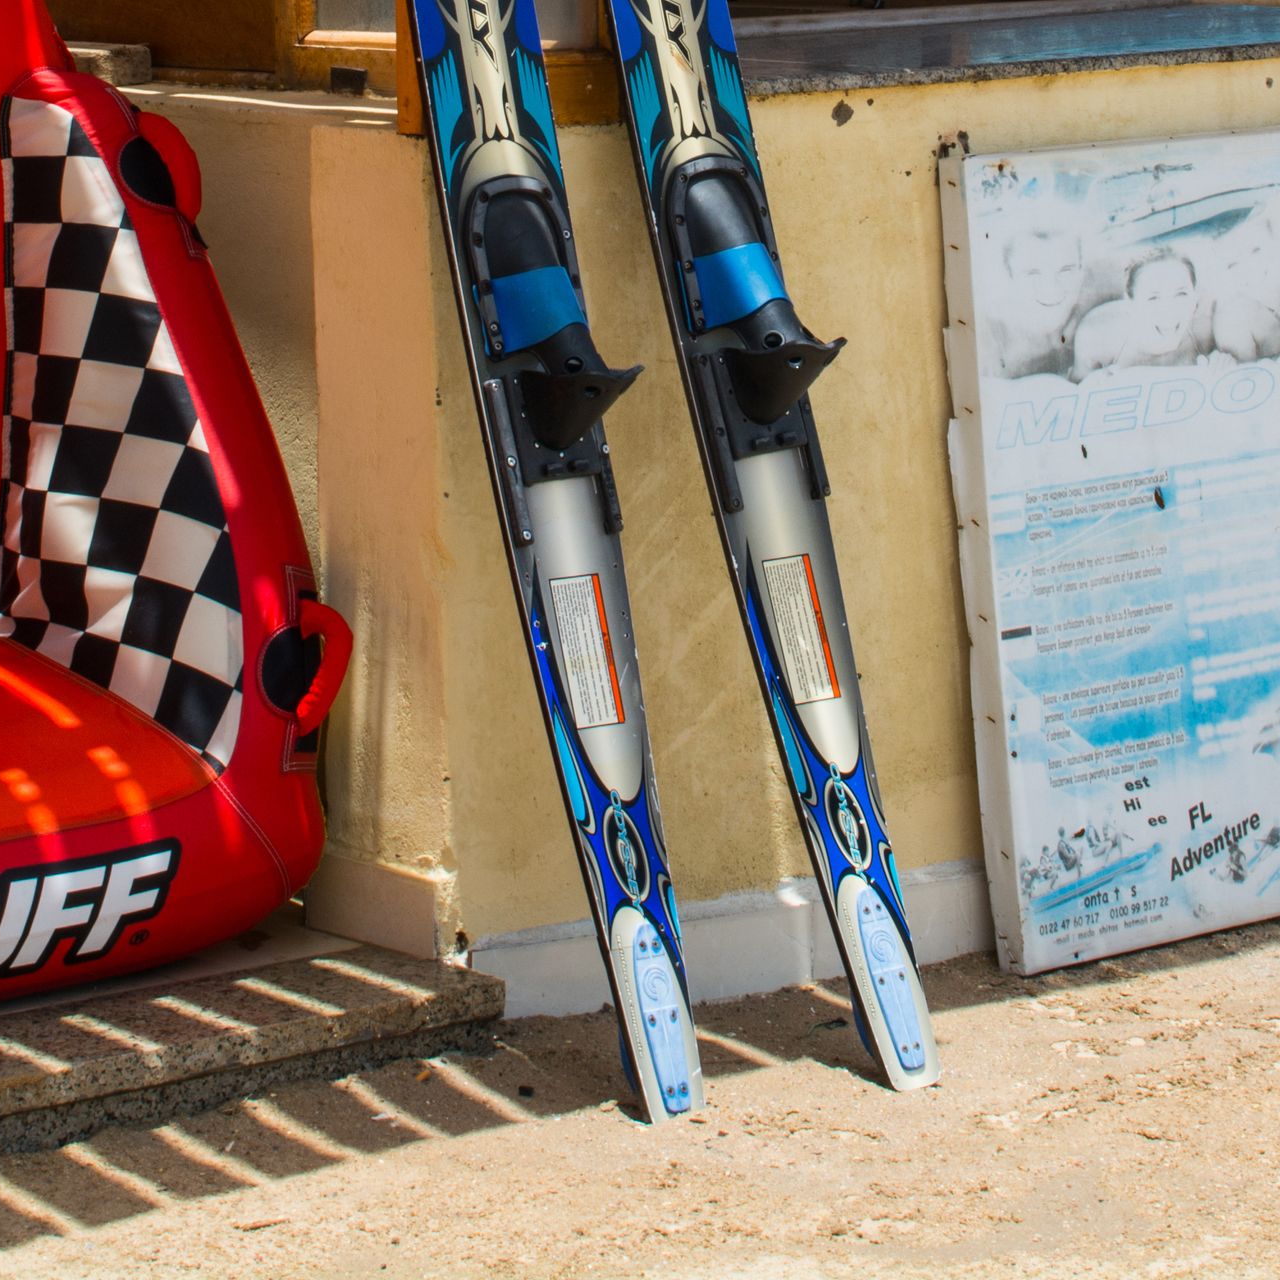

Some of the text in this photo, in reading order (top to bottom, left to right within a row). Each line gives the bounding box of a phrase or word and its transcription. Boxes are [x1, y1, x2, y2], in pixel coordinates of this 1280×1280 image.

[995, 366, 1276, 450] MEDO
[1124, 775, 1151, 792] est
[829, 761, 870, 888] ODYSSEY
[1123, 797, 1142, 813] Hi
[1147, 814, 1168, 828] ee
[1187, 800, 1213, 831] FL
[610, 788, 646, 919] ODYSSEY
[1170, 811, 1261, 882] Adventure
[1039, 922, 1059, 936] 0122
[1061, 919, 1071, 931] 47
[1085, 912, 1100, 925] 717
[1109, 905, 1129, 920] 0100
[1131, 902, 1141, 915] 99
[1159, 896, 1169, 908] 22
